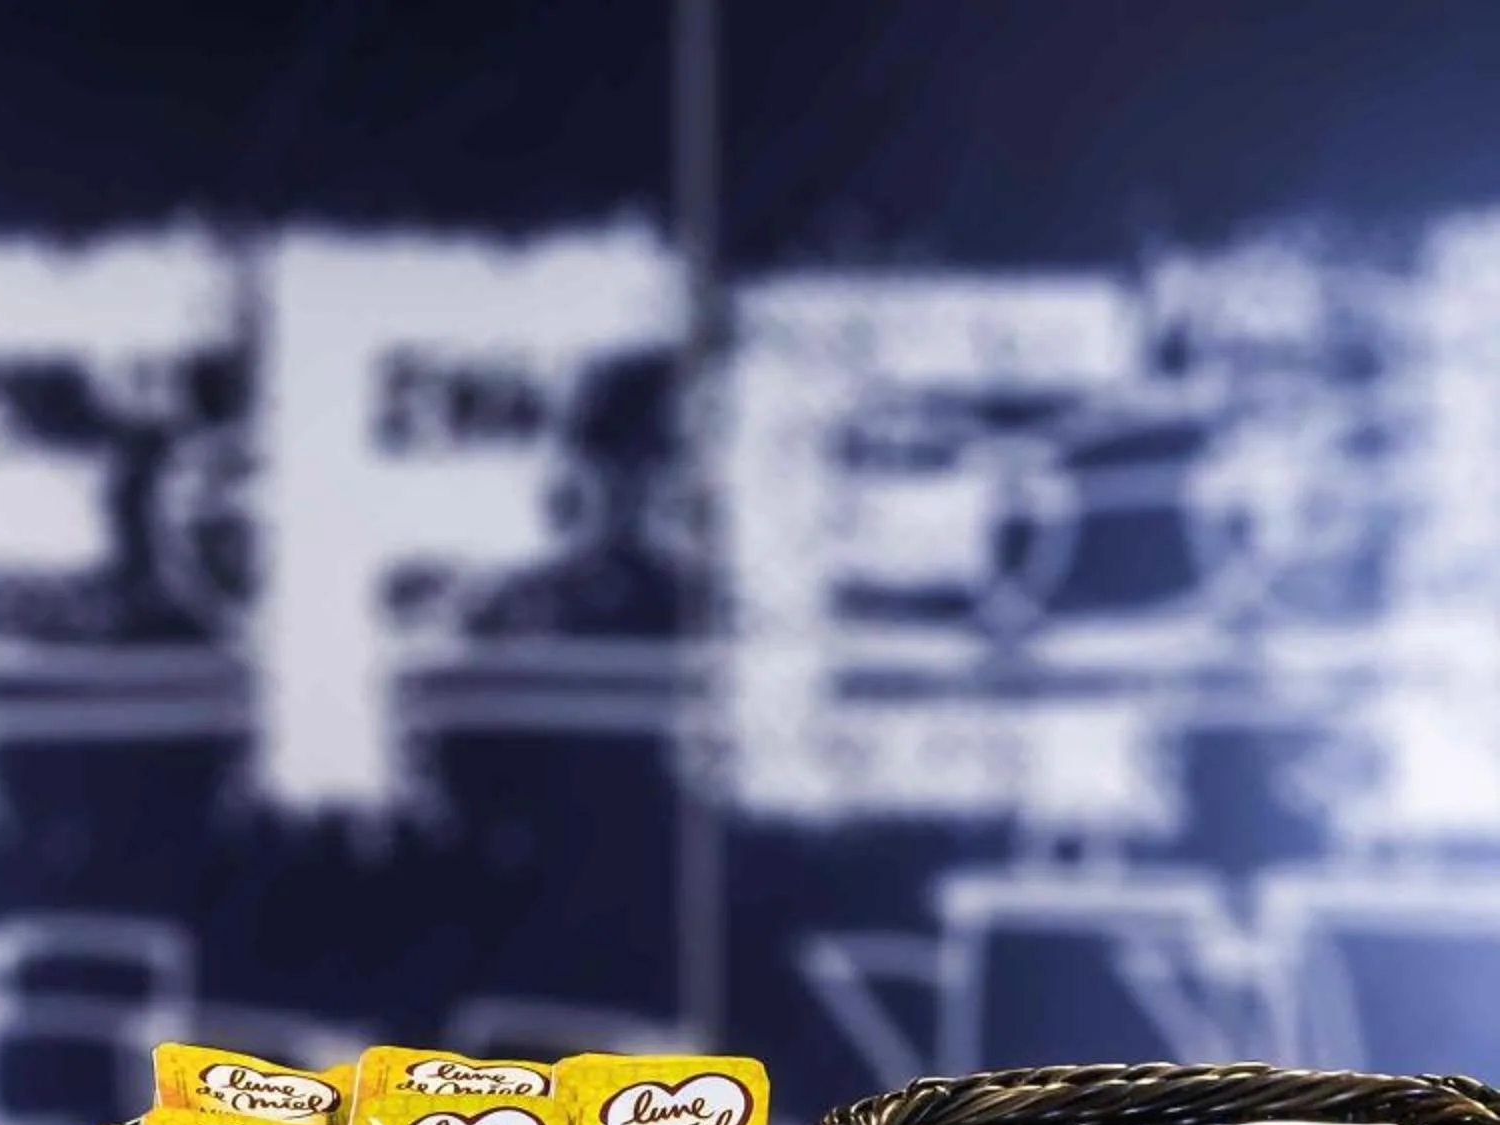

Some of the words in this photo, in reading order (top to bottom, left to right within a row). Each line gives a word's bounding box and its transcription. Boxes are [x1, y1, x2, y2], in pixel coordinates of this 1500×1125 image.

[219, 1069, 304, 1091] lune
[196, 1086, 226, 1104] de
[622, 1089, 714, 1125] lune
